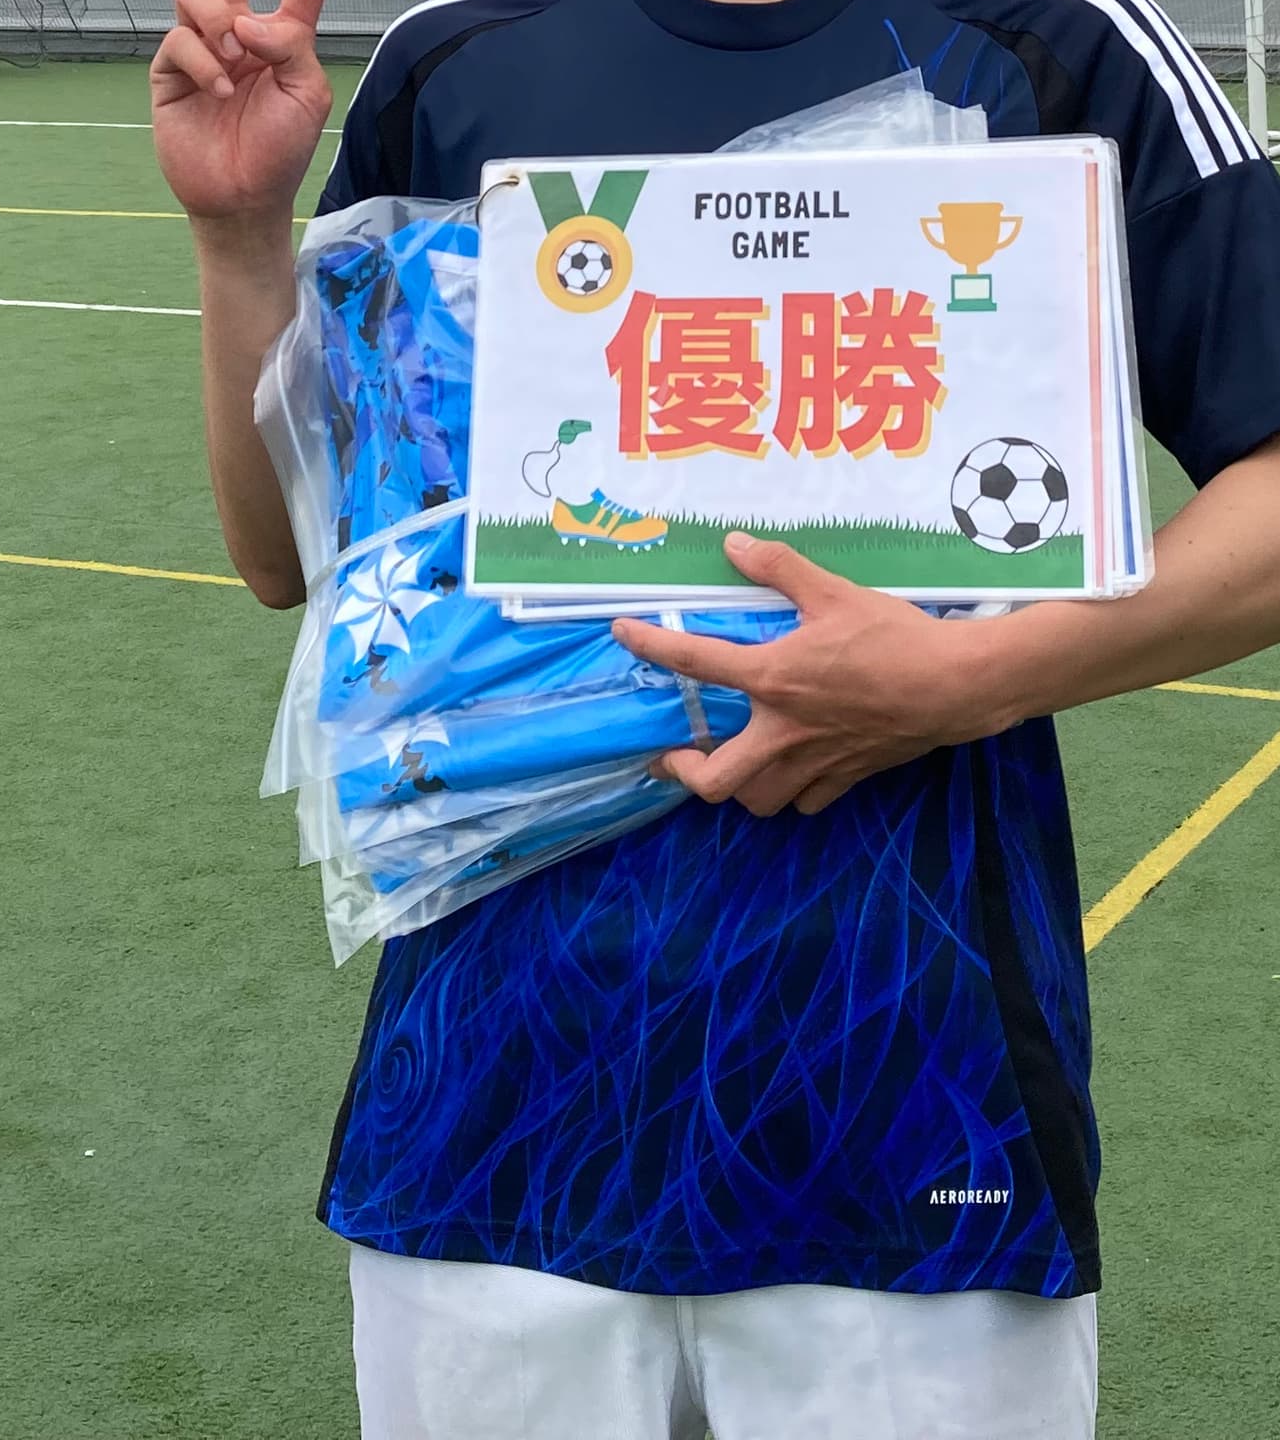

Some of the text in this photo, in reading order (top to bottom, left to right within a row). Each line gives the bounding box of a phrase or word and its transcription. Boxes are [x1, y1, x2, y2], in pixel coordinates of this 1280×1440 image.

[694, 191, 850, 220] FOOTBALL
[732, 231, 810, 258] GAME
[605, 288, 949, 460] 優勝
[929, 1189, 1009, 1205] AEROREADY
